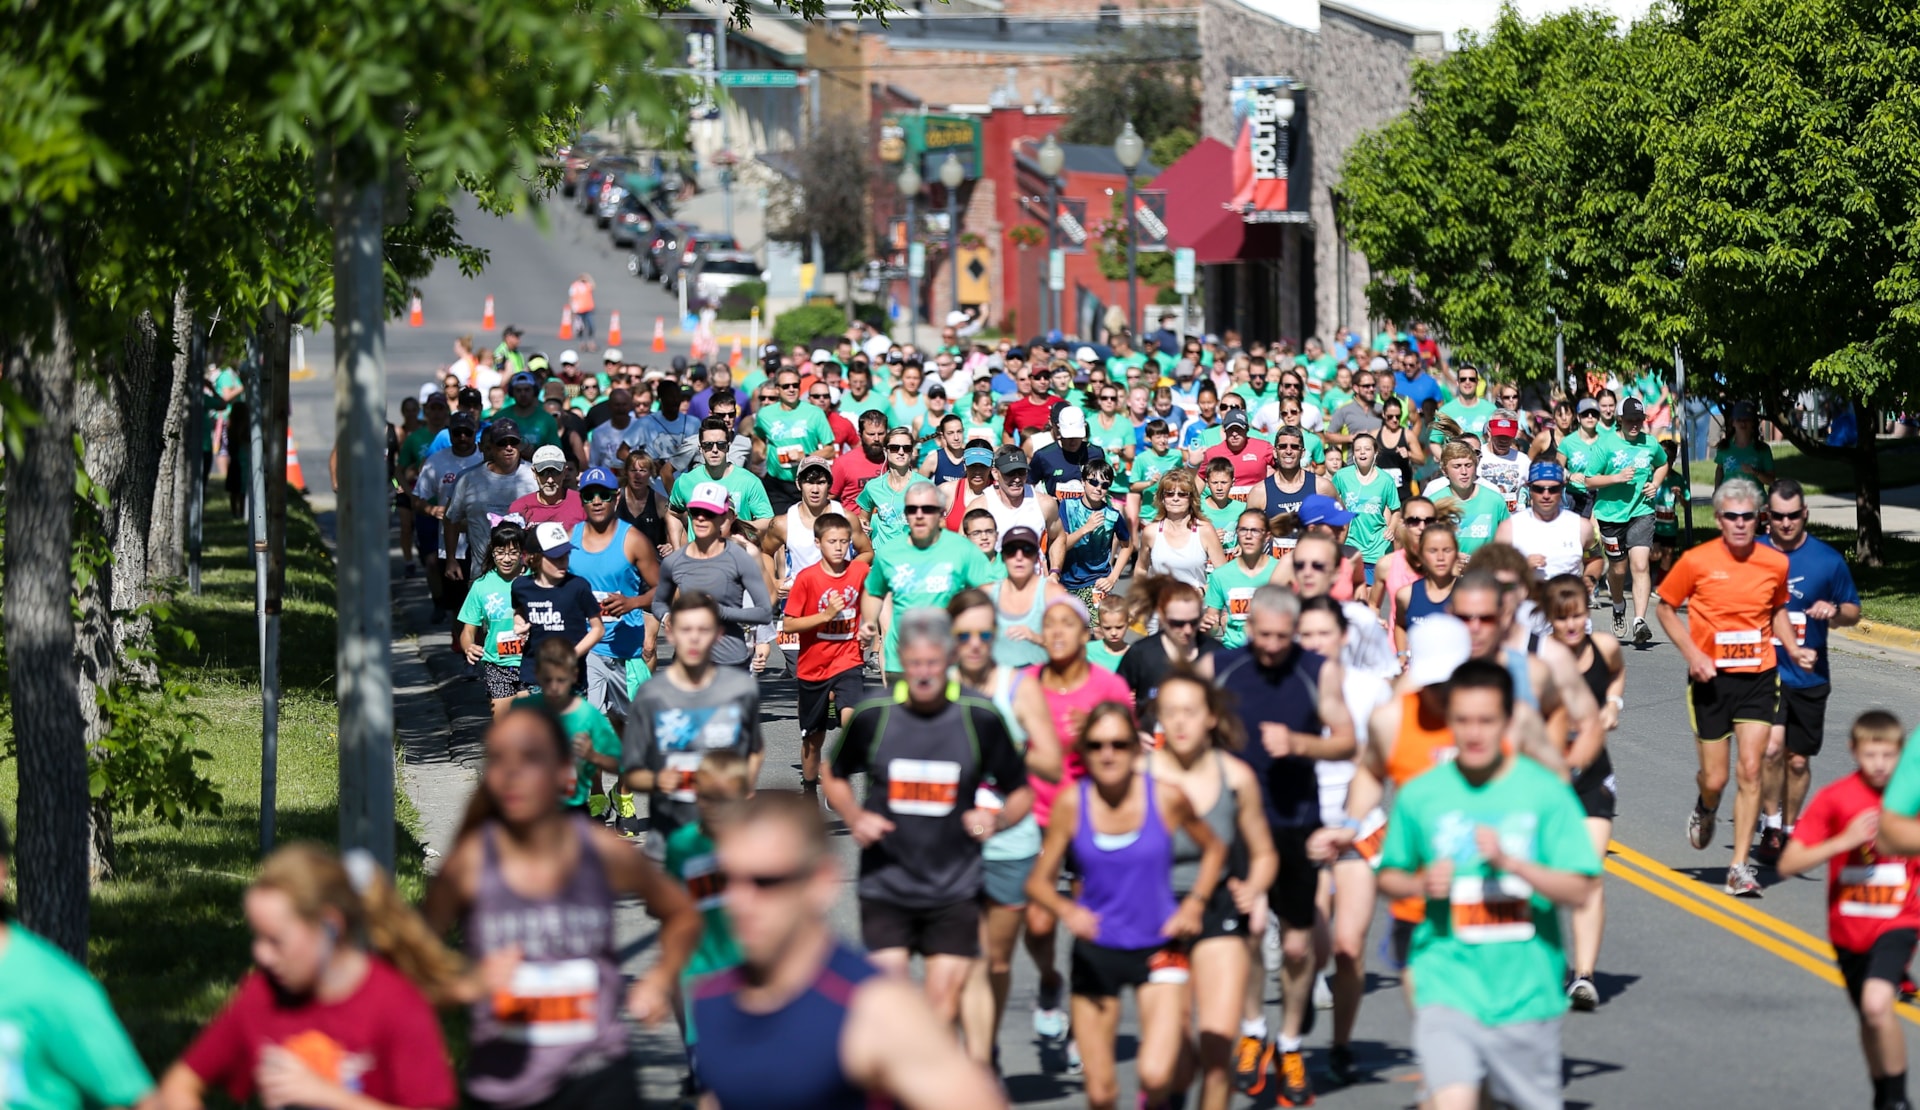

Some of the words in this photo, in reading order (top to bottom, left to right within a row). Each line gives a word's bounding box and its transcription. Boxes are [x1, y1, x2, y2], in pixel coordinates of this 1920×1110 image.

[1255, 93, 1277, 179] HOLTER
[528, 607, 565, 624] dude.
[1722, 644, 1755, 659] 3253
